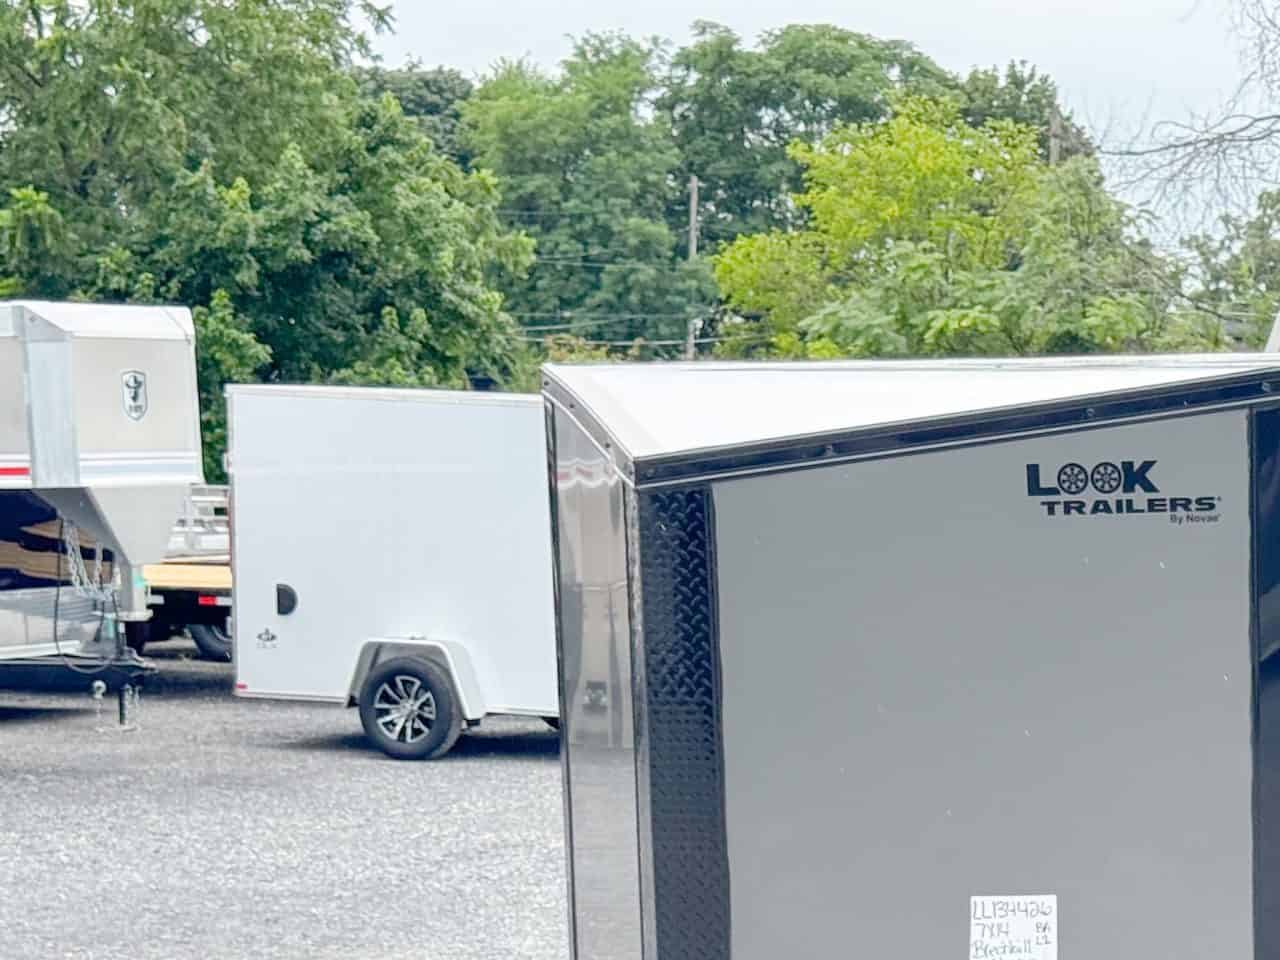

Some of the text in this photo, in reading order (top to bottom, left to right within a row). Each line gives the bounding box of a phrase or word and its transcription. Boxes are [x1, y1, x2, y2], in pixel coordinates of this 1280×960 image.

[1026, 460, 1160, 496] LOOK
[1040, 496, 1218, 516] TRAILERS
[1170, 513, 1183, 525] By
